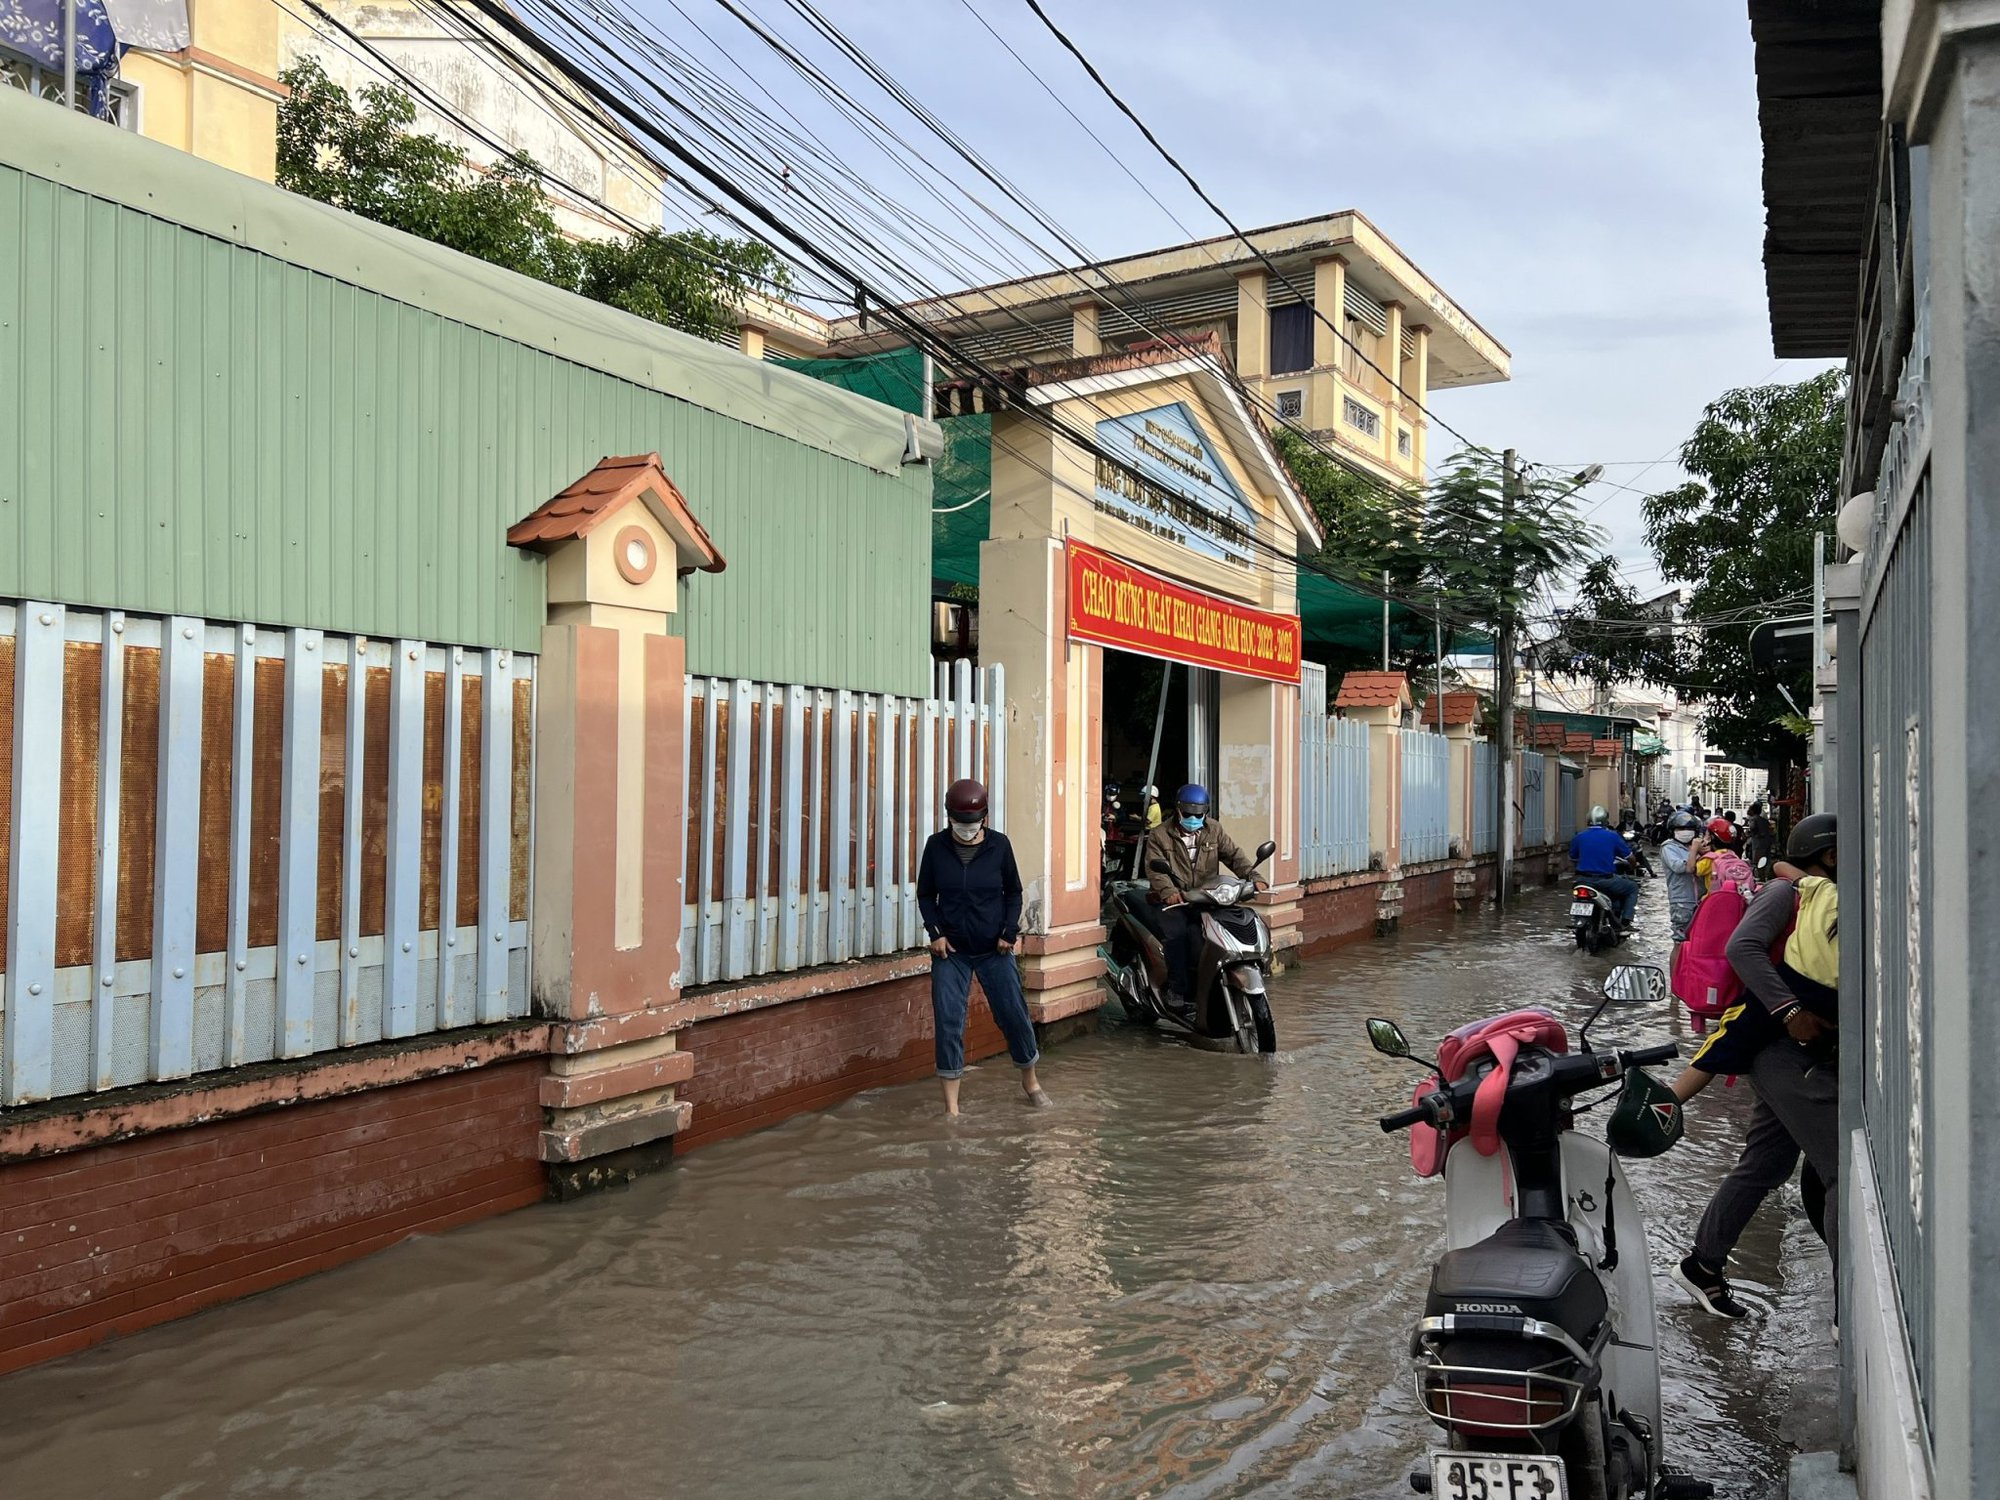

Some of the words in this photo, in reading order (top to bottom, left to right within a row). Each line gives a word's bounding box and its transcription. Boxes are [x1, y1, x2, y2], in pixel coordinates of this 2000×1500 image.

[1082, 559, 1112, 620] CHÀO
[1115, 568, 1145, 629] MỪNG
[1146, 581, 1172, 636] NGÀY
[1173, 598, 1195, 642] KHAI
[1222, 607, 1240, 653] NĂM
[1240, 618, 1256, 667] HỌC
[1257, 623, 1274, 660] 2022
[1277, 628, 1293, 665] 2023
[1455, 1303, 1523, 1314] HONDA
